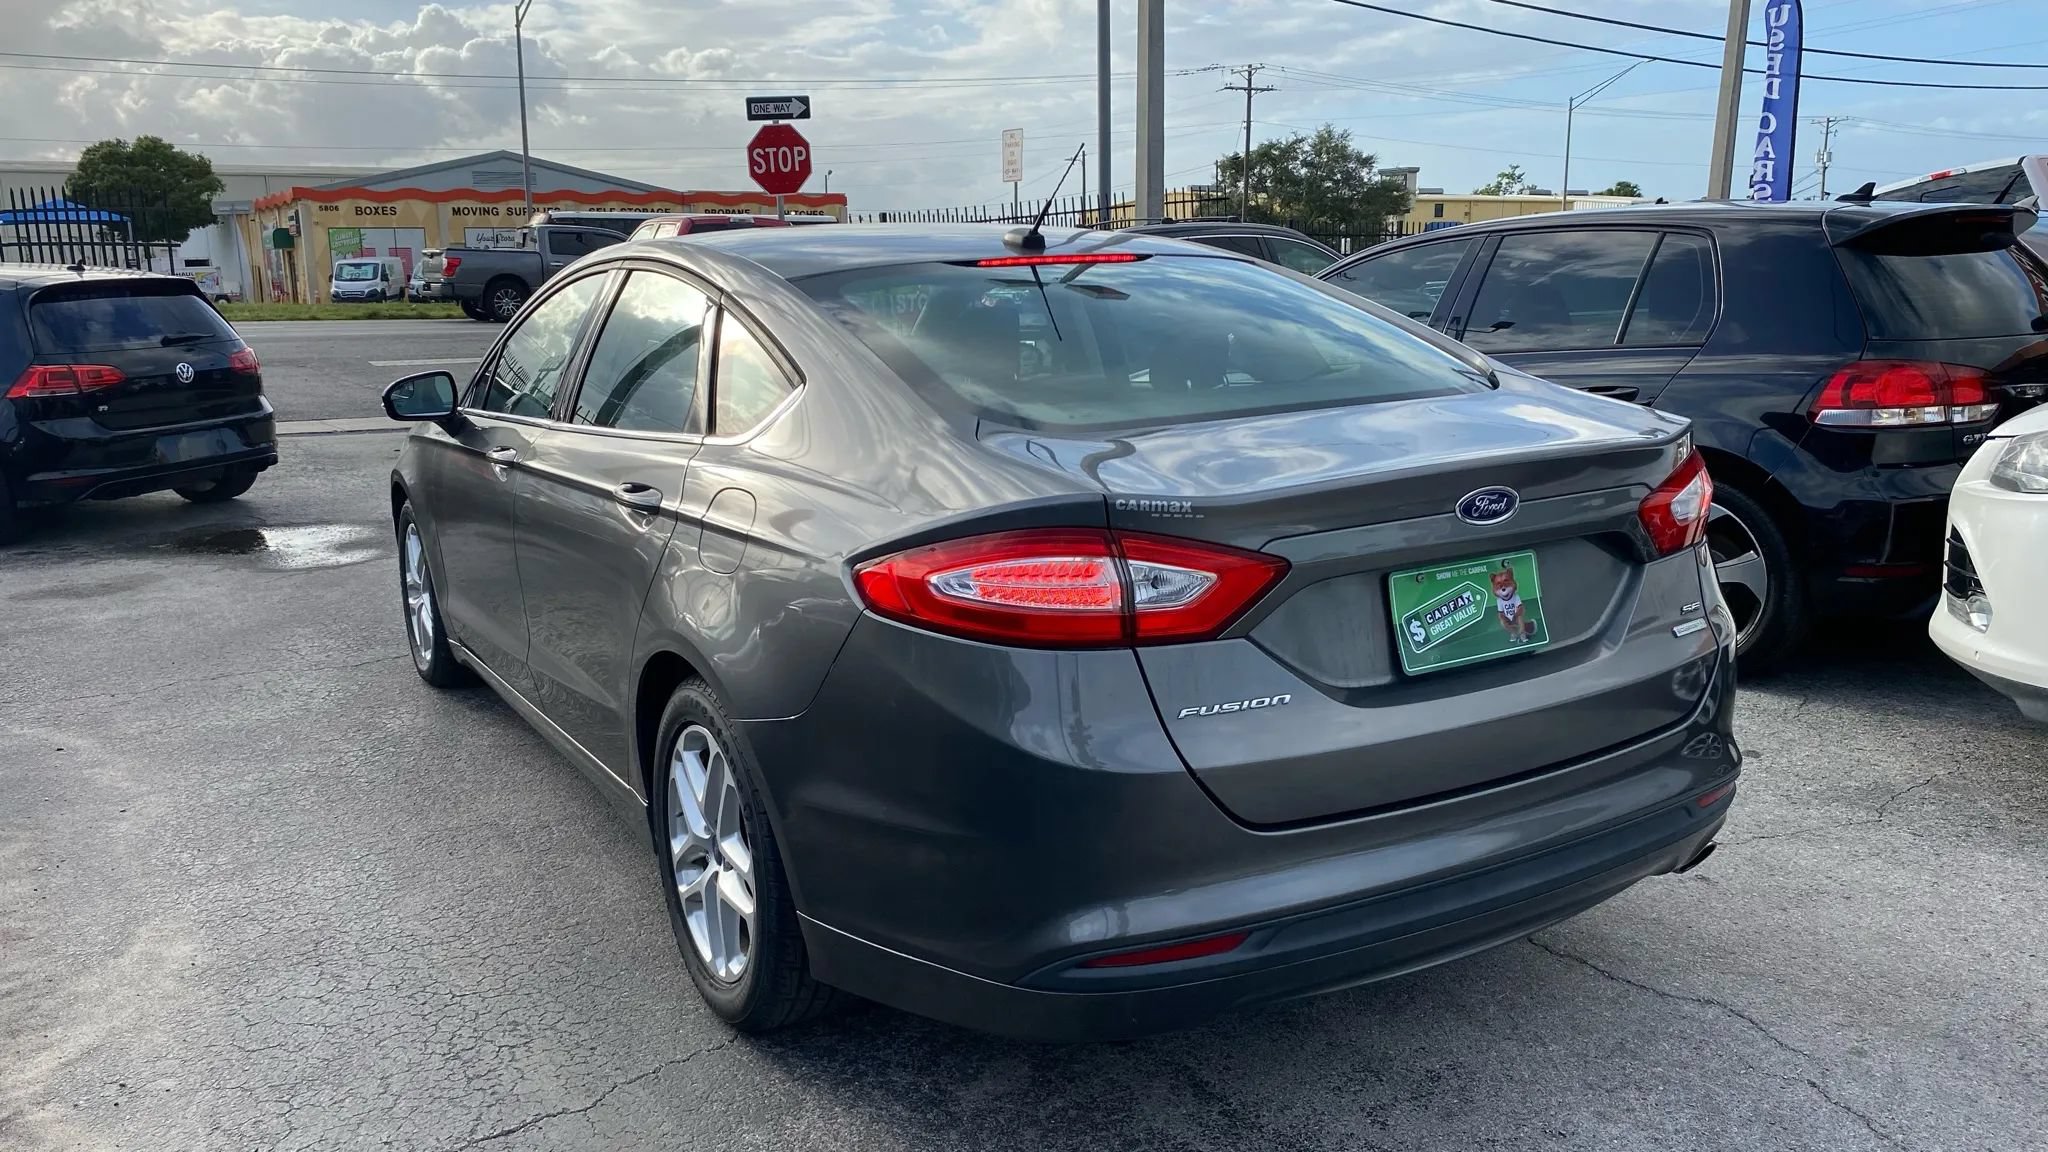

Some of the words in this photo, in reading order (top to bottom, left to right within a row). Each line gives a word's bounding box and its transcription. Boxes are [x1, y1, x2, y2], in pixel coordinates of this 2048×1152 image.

[753, 104, 771, 114] ONE
[773, 103, 791, 113] WAY
[752, 146, 807, 174] STOP
[354, 206, 398, 216] BOXES
[451, 206, 499, 217] MOVING
[506, 206, 561, 216] SUPIE
[1962, 432, 1988, 445] GTI
[1471, 494, 1508, 517] Ford
[1435, 571, 1451, 581] SHOW
[1468, 565, 1488, 575] CARFAX
[1425, 591, 1474, 625] CARFAX
[1430, 618, 1454, 636] GREAT
[1454, 605, 1478, 623] VALUE
[1178, 694, 1292, 719] FUSION
